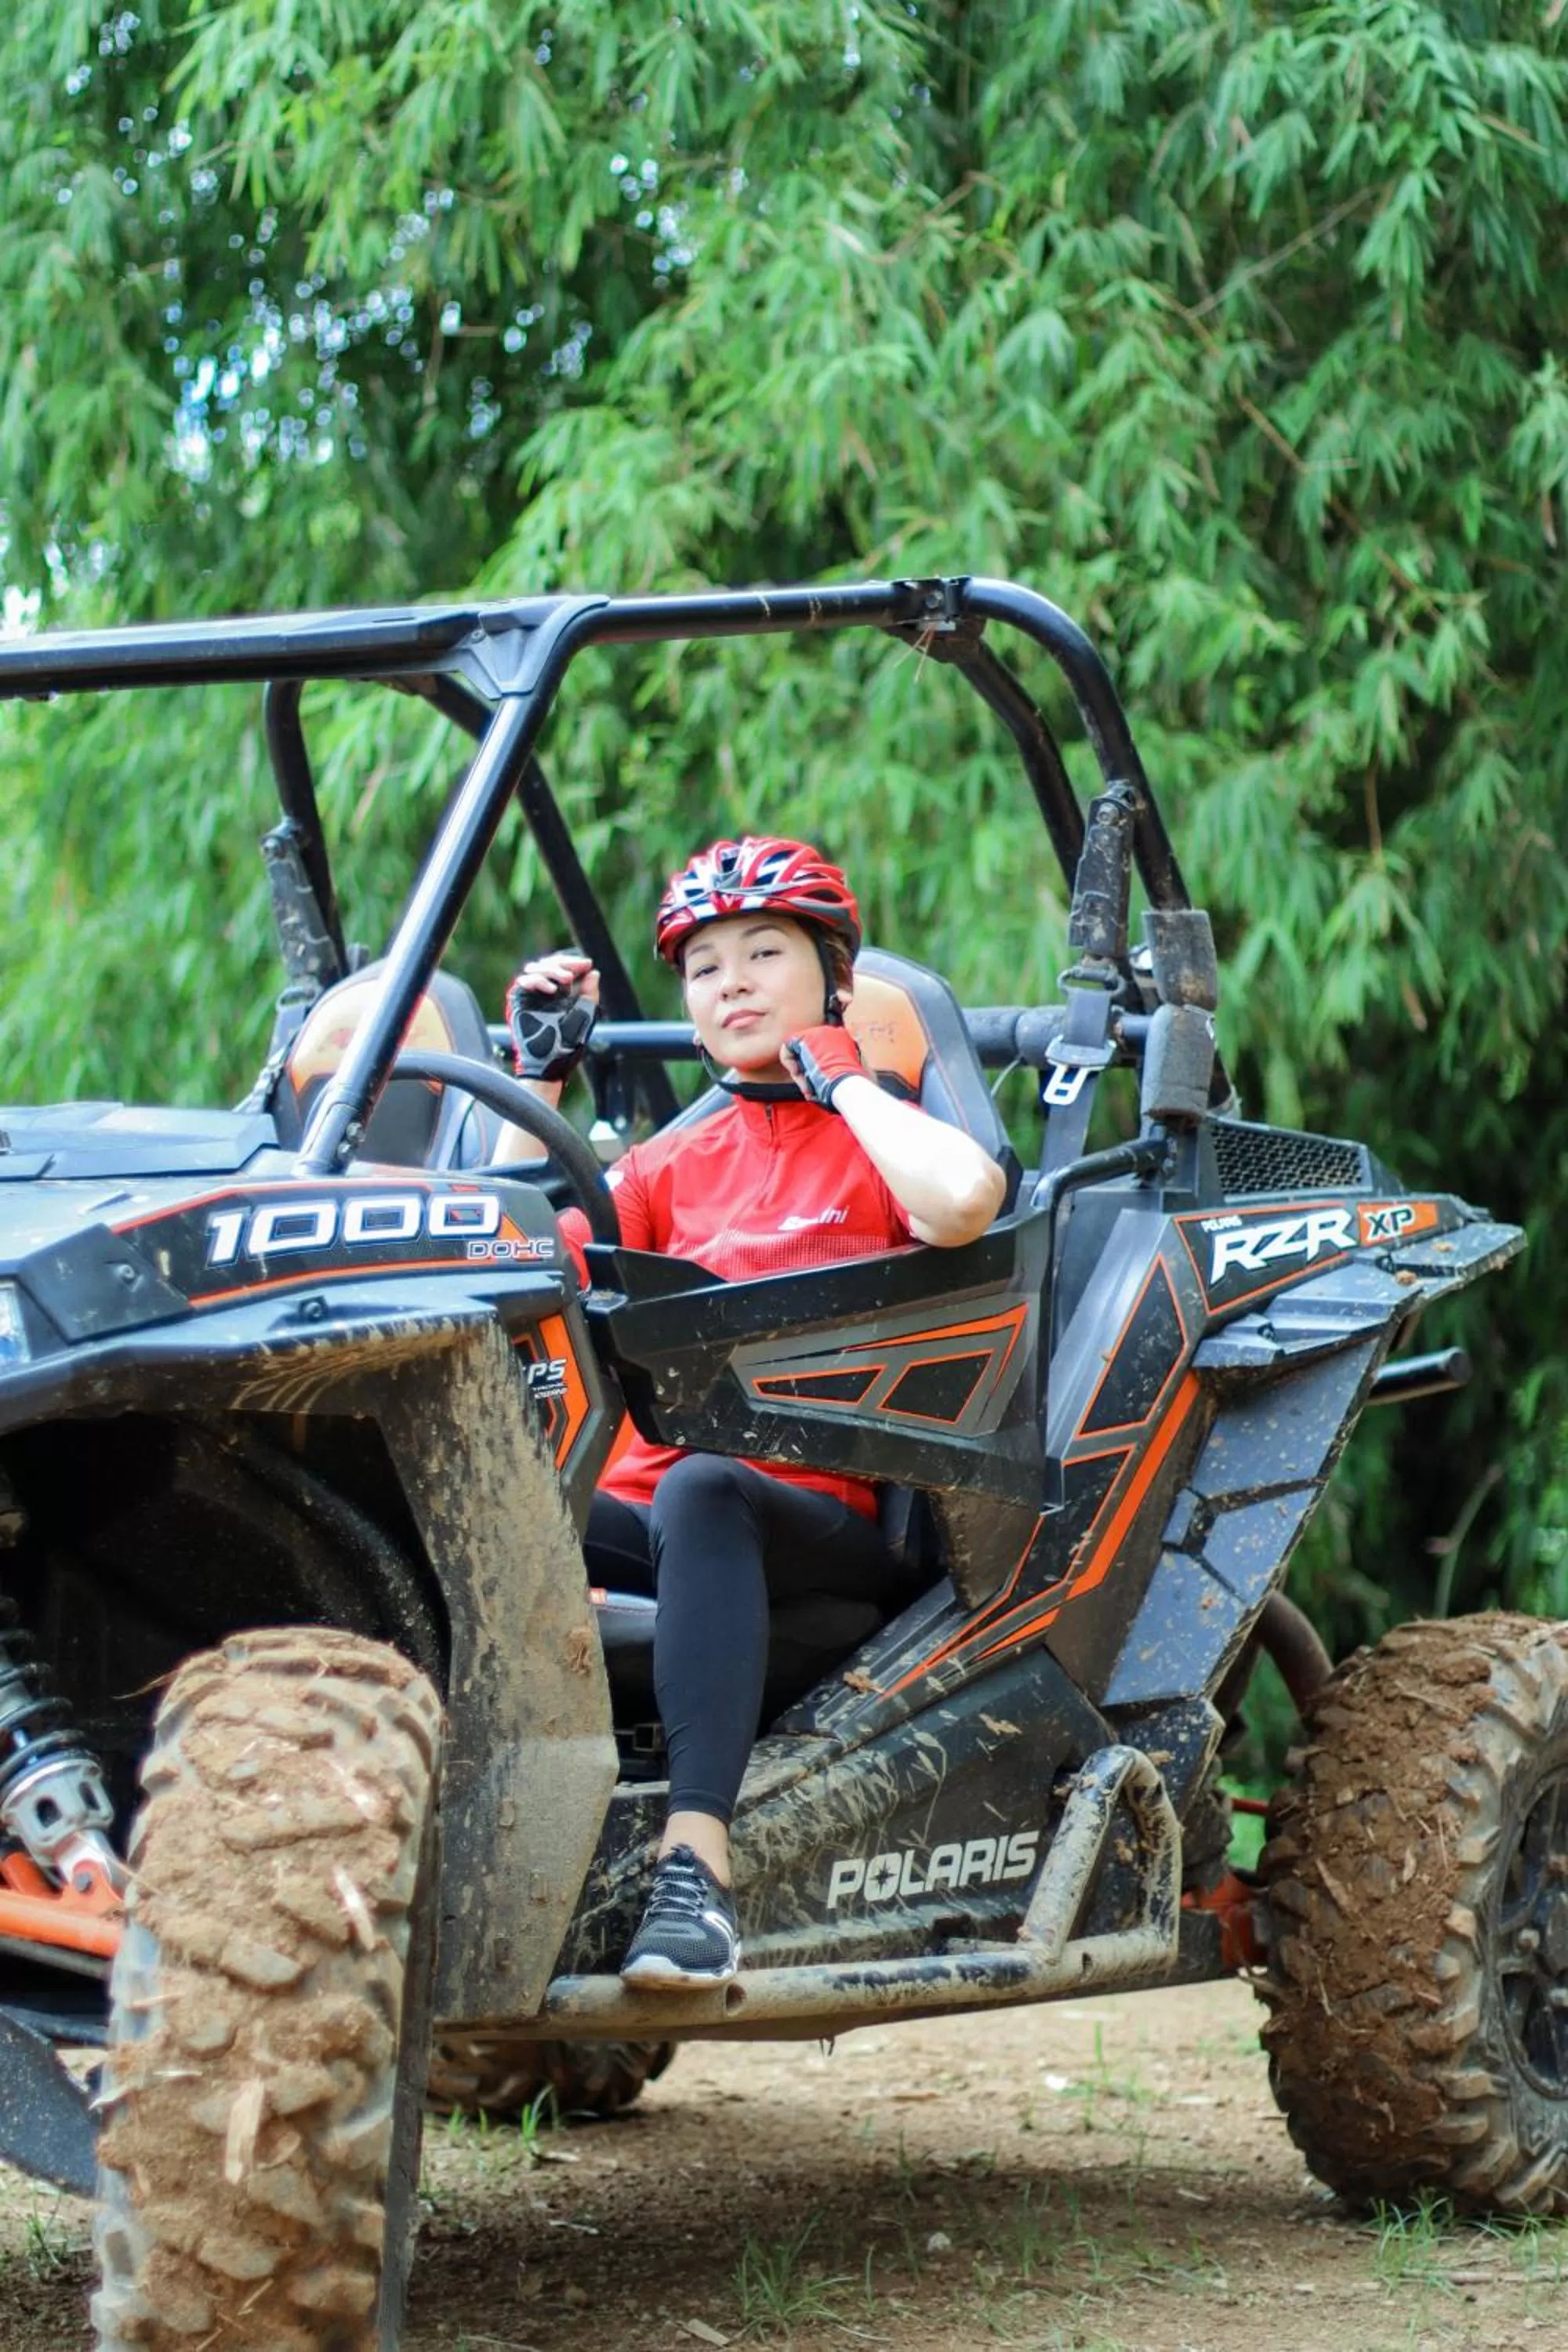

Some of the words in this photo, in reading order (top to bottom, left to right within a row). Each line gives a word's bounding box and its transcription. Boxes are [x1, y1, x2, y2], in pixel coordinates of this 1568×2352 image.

[208, 1192, 500, 1265] 1000
[467, 1237, 554, 1259] DOHC
[1210, 1207, 1359, 1284] RZR
[1364, 1204, 1415, 1240] XP
[522, 1358, 567, 1385] PS
[827, 1831, 1040, 1909] POLARIS
